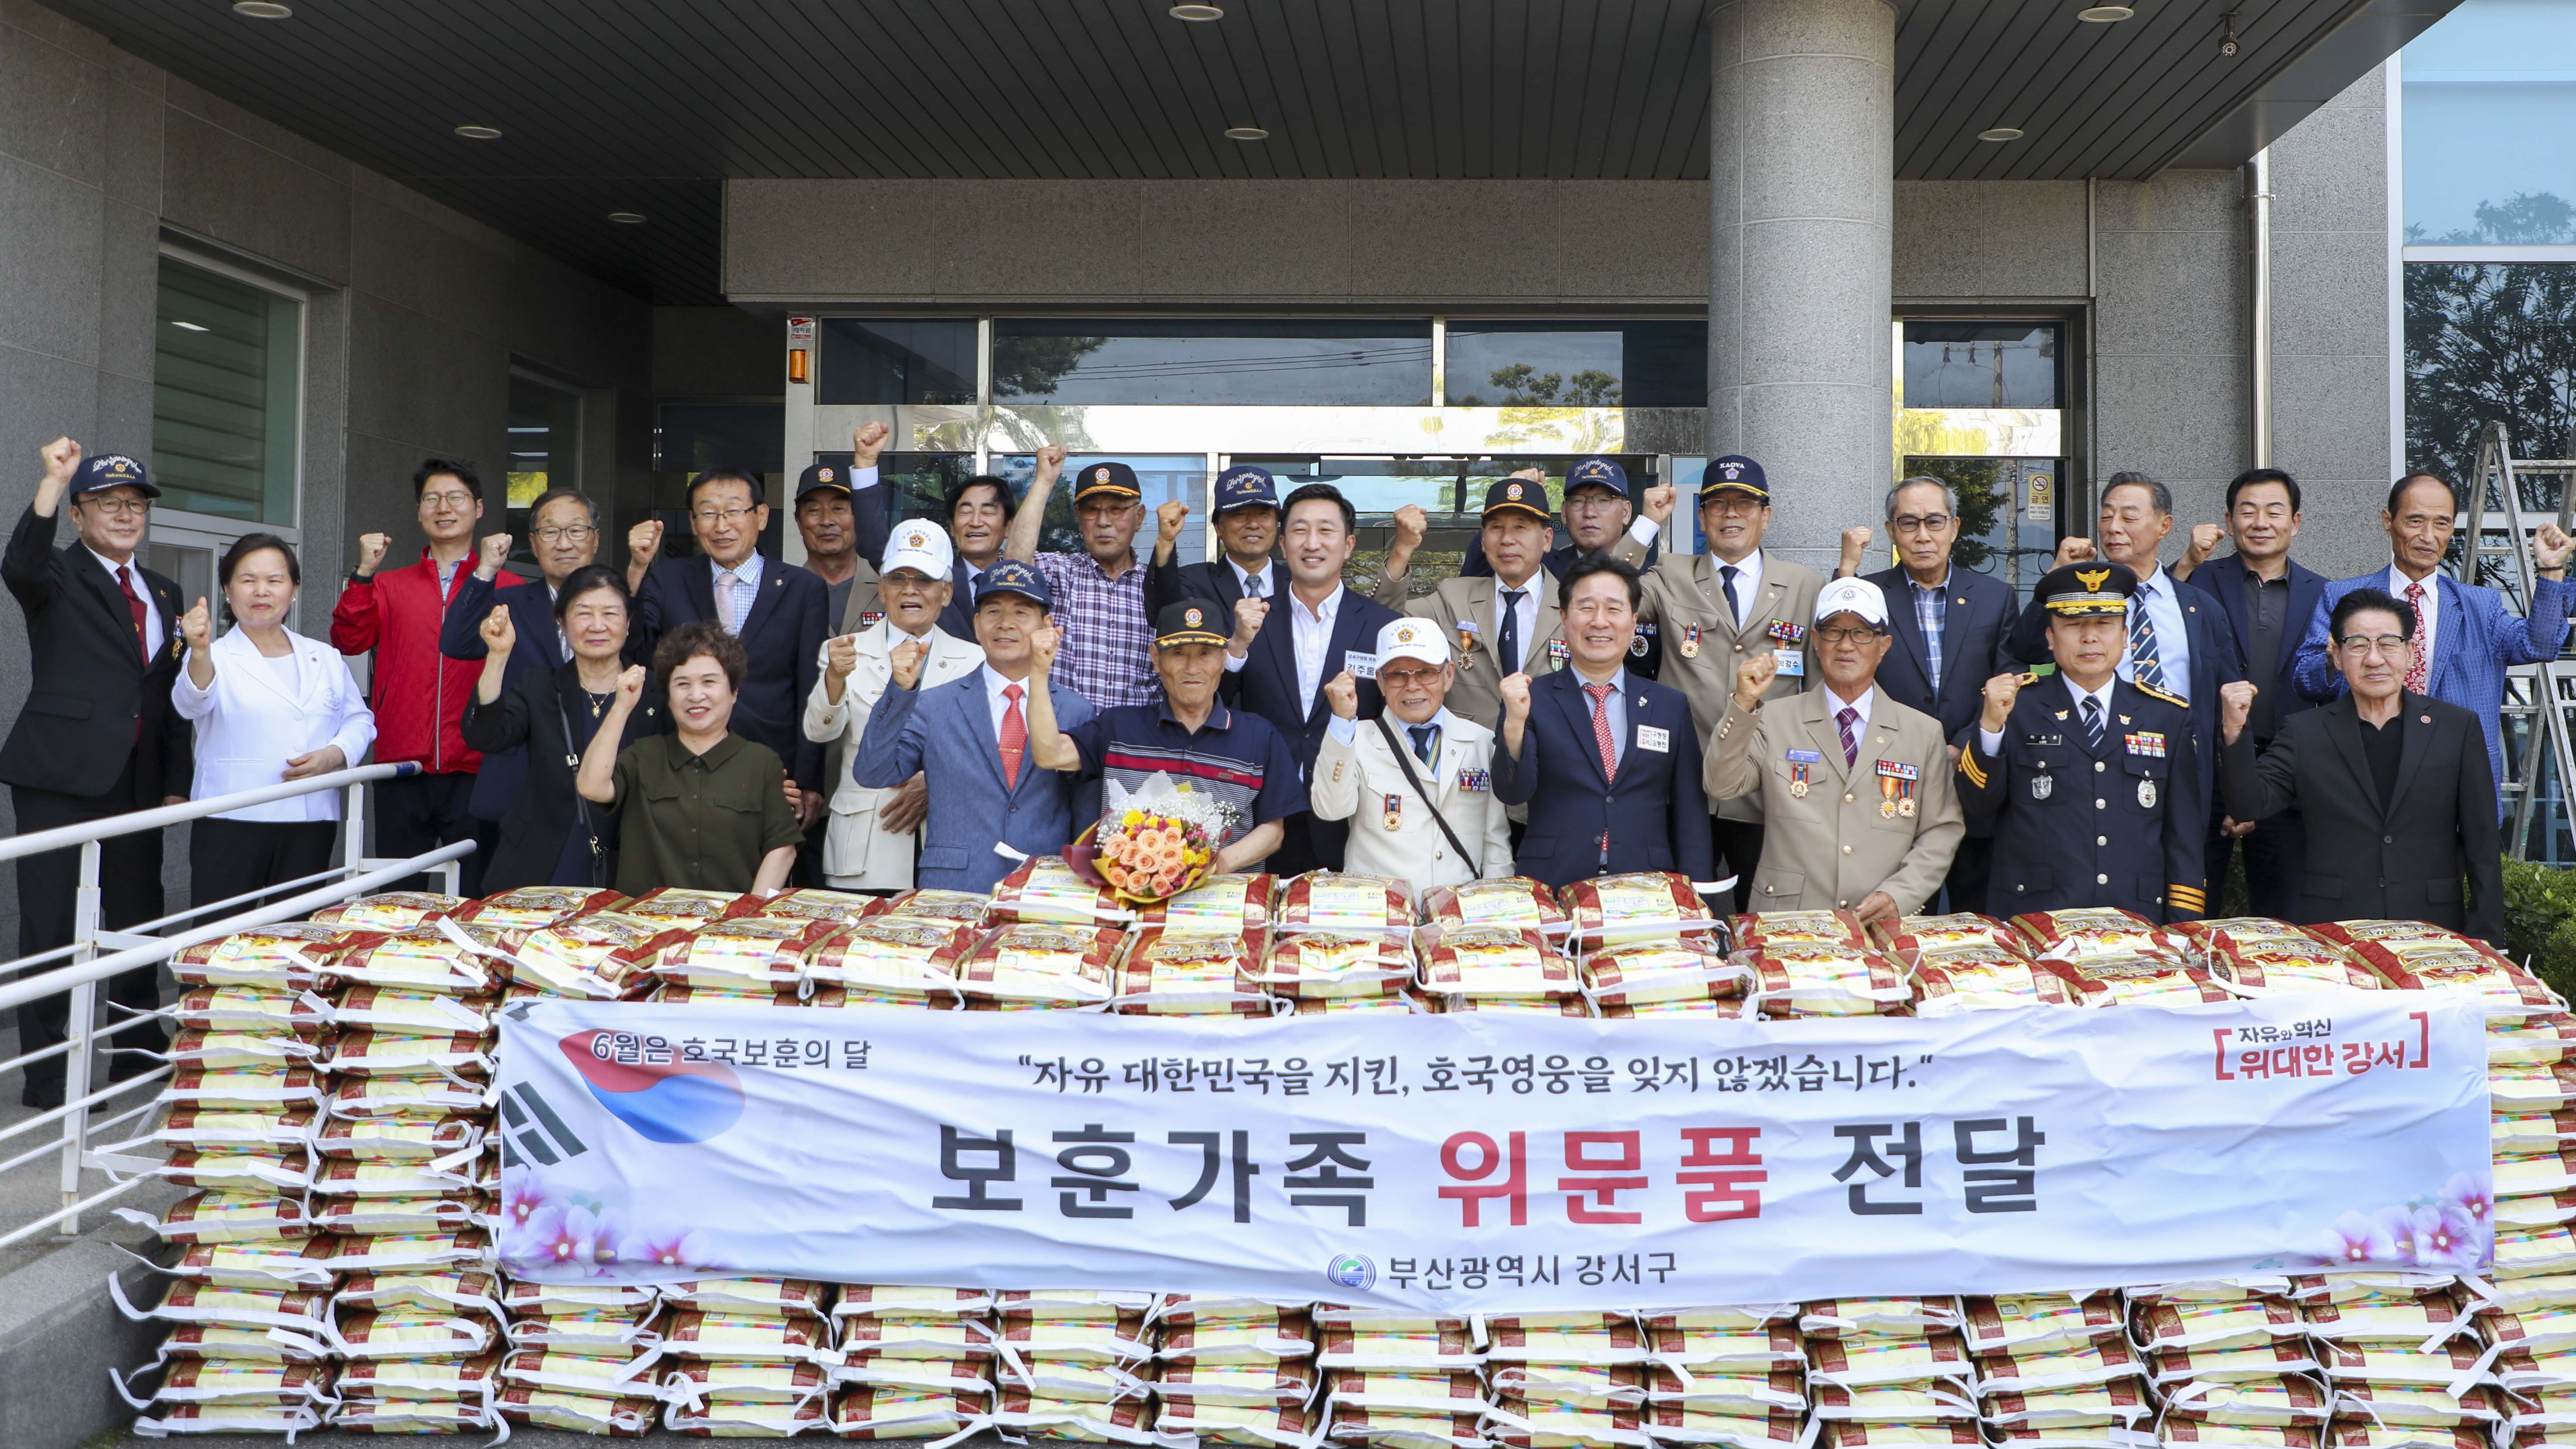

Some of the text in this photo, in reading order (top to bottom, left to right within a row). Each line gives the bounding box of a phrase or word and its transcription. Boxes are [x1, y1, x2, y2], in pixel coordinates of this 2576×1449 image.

[1653, 731, 1667, 740] 구청장
[590, 1032, 872, 1070] 6월은 호국보훈의 달
[2239, 1040, 2405, 1080] 위대한 강서
[1122, 1055, 1314, 1096] 대한민국을
[1324, 1055, 1411, 1098] 지킨,
[1422, 1053, 1616, 1095] 호국영웅을
[1627, 1055, 1698, 1093] 잊지
[932, 1115, 2046, 1228] 보훈가족 위문품 전달
[1388, 1252, 1678, 1290] 부산광역시 강서구
